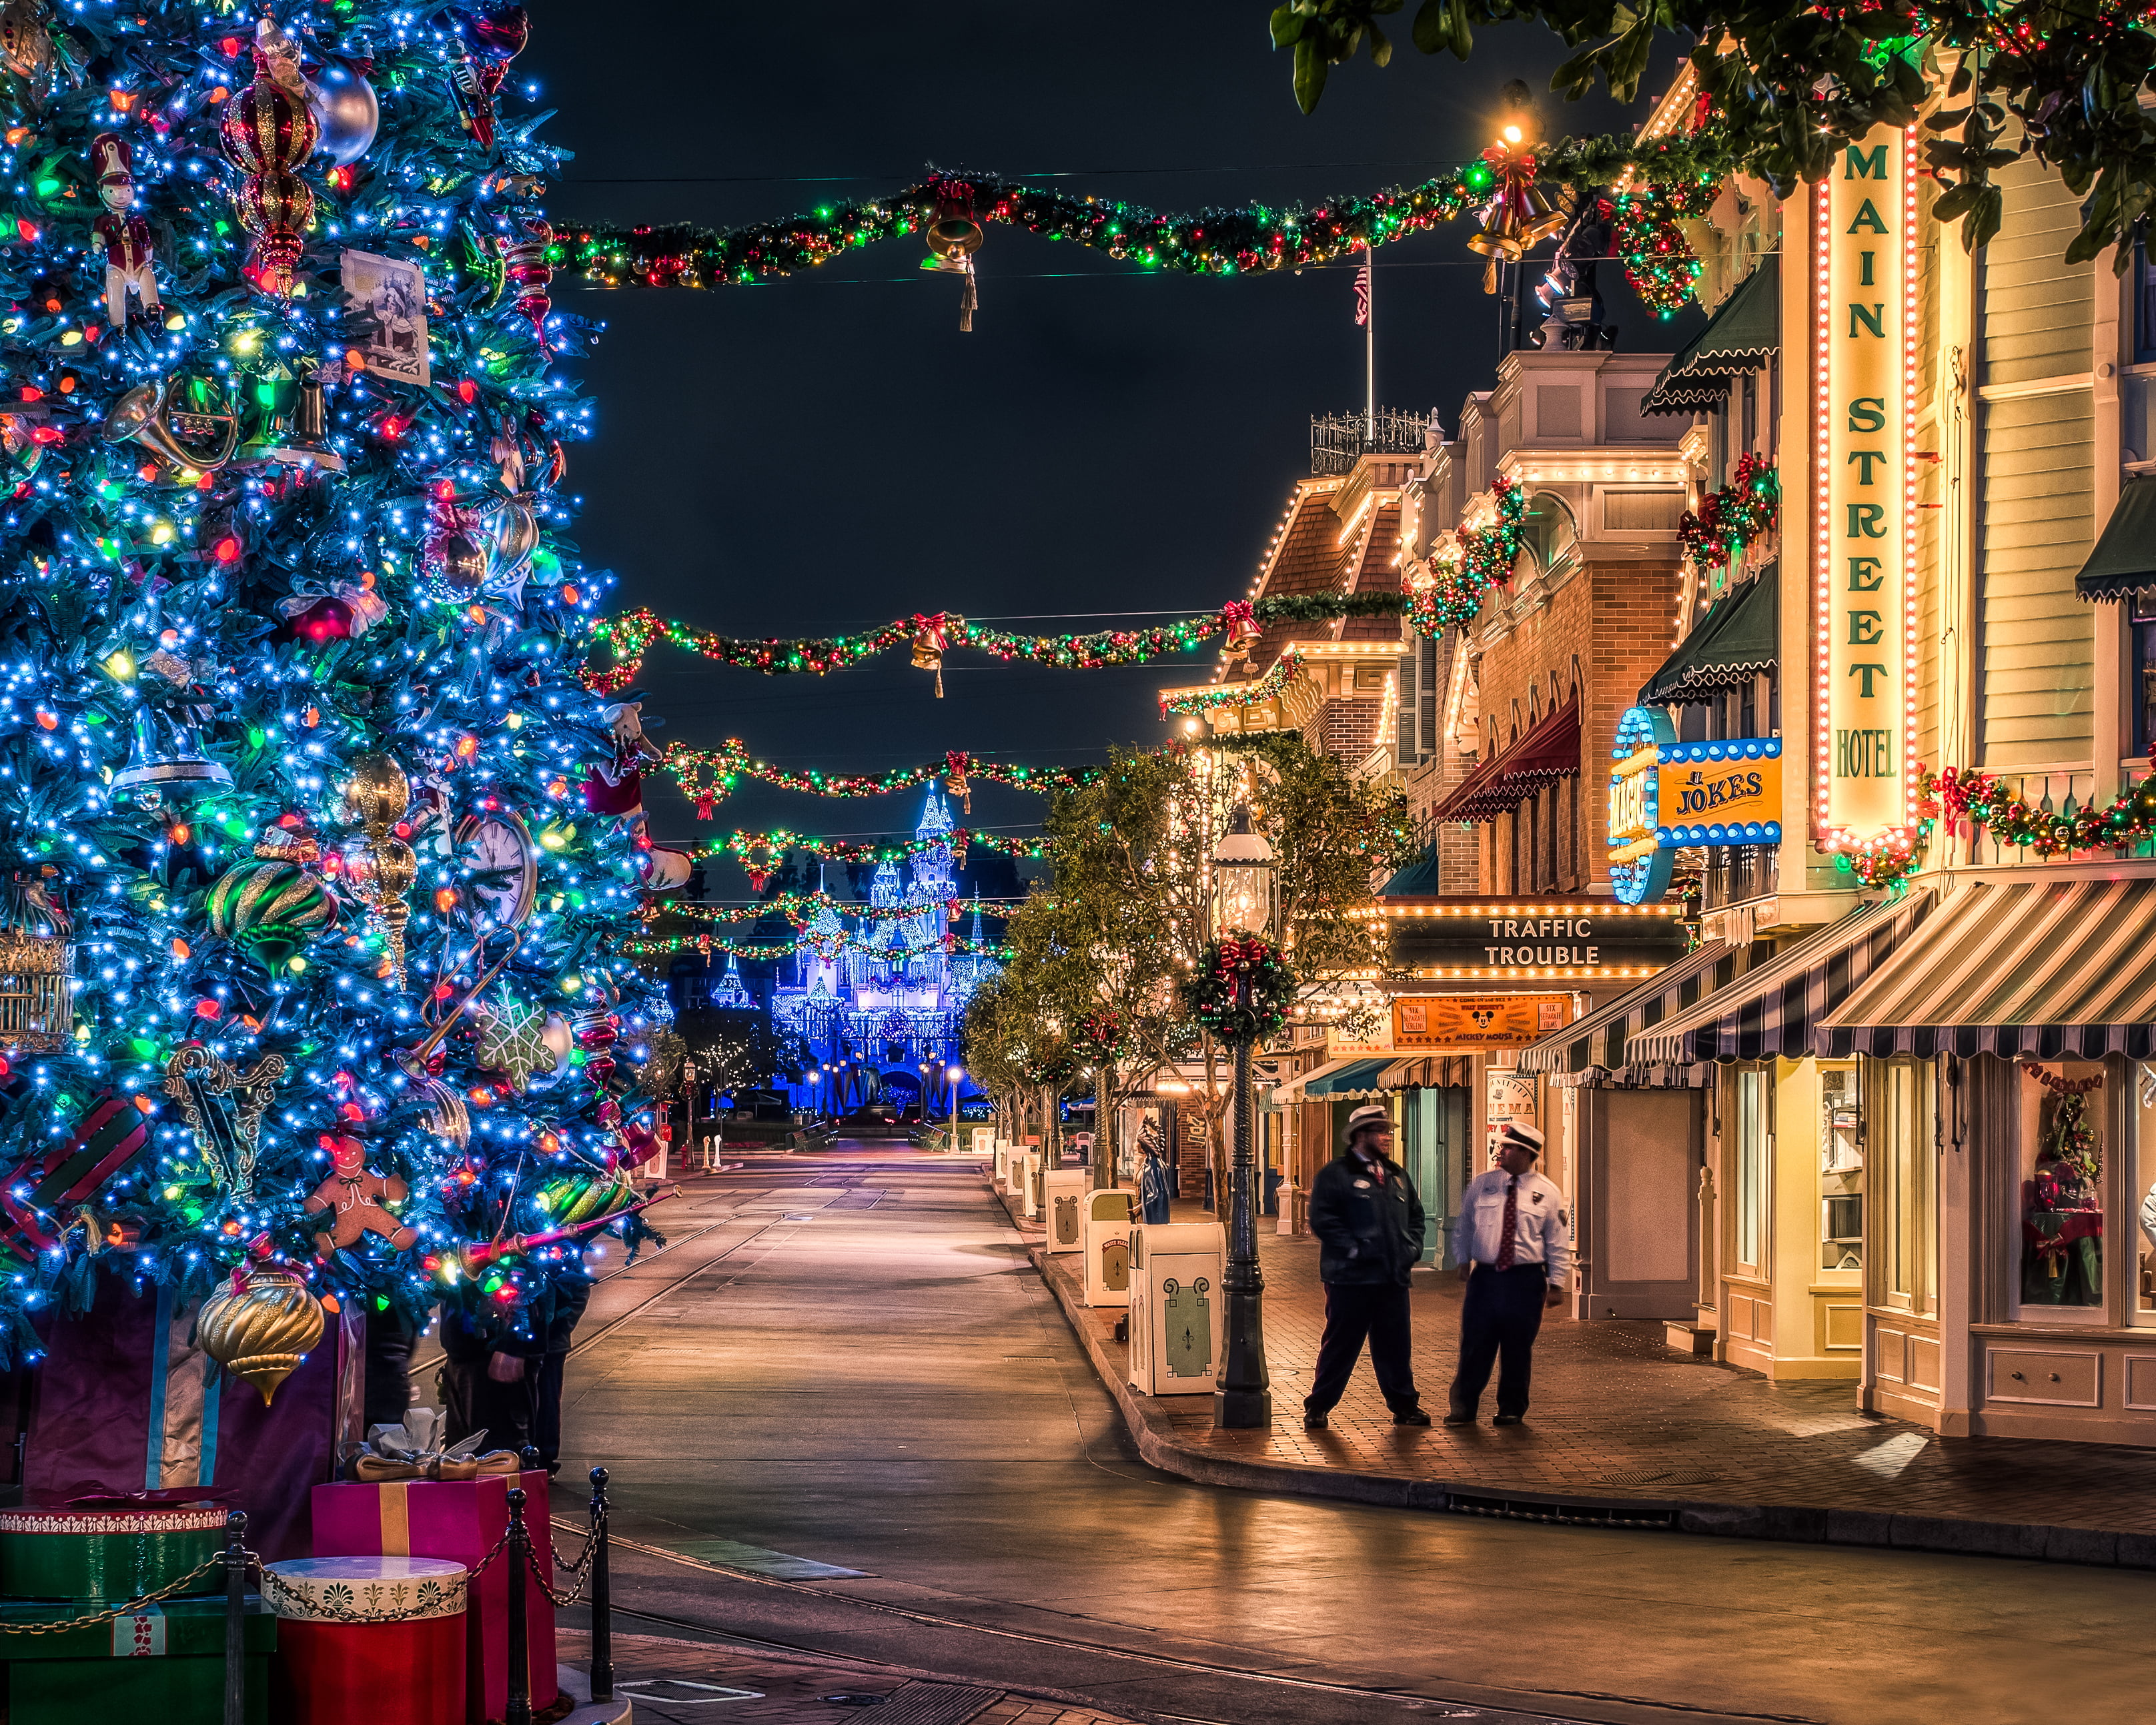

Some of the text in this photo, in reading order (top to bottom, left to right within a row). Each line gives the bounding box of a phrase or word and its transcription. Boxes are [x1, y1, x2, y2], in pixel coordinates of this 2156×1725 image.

[1844, 145, 1889, 698] MAIN STREET
[1836, 728, 1897, 778] HOTEL
[1676, 772, 1763, 815] JOKES
[1610, 769, 1646, 838] MAGIC
[1488, 919, 1591, 938] TRAFFIC
[1484, 946, 1600, 965] TROUBLE
[1403, 1014, 1425, 1023] SEPARATE
[1540, 1012, 1562, 1021] SEPARATE
[1543, 1021, 1558, 1029] FILMS
[1486, 1033, 1513, 1041] MOUSE
